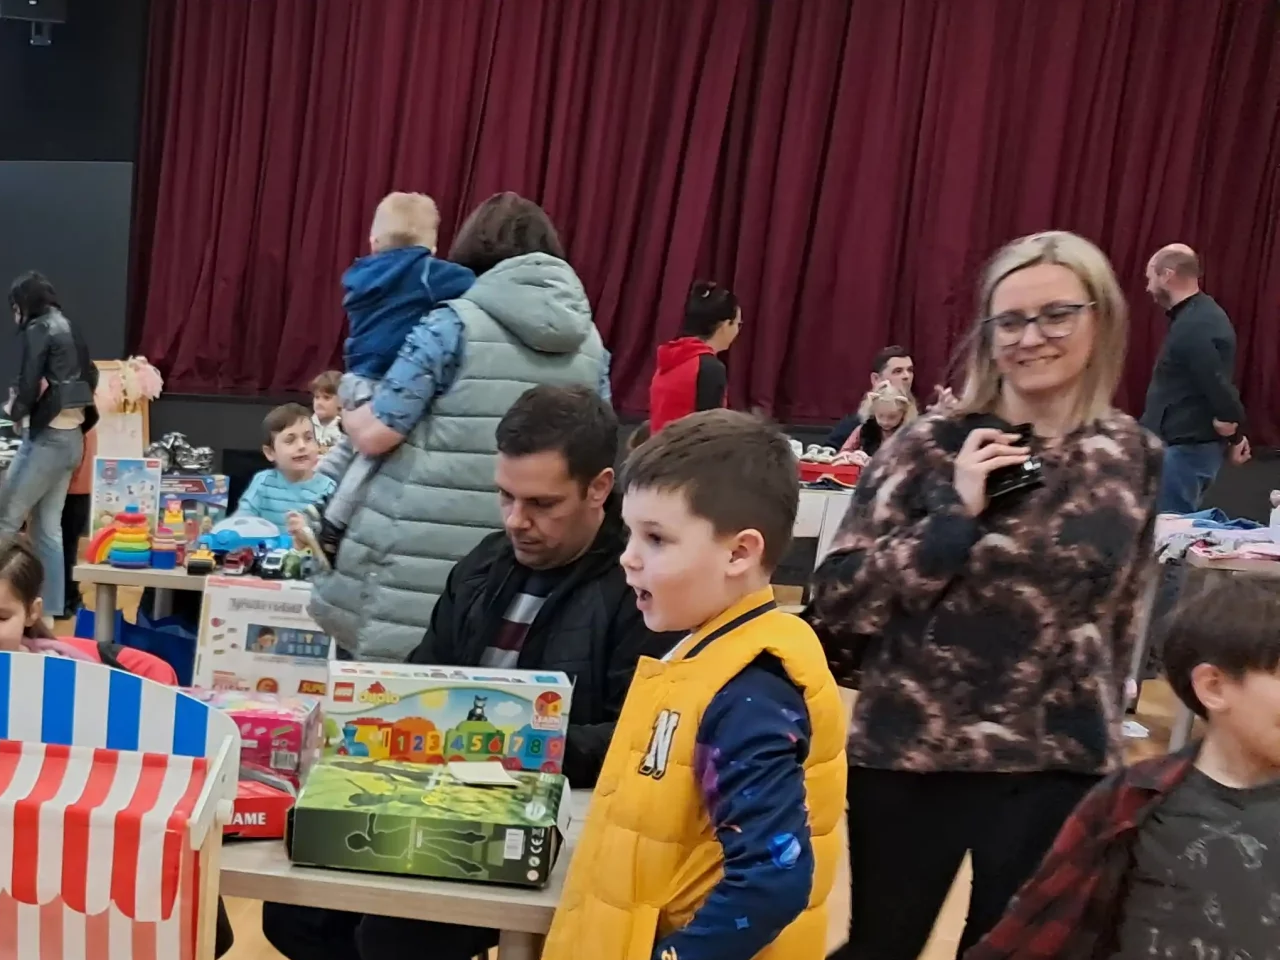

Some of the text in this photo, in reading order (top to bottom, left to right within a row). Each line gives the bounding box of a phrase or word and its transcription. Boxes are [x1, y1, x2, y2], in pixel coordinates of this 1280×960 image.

[397, 735, 405, 752] 1
[413, 735, 424, 752] 2
[428, 734, 440, 752] 3
[450, 734, 465, 751] 4
[470, 734, 483, 752] 5
[512, 736, 524, 754] 7
[530, 738, 542, 755] 8
[638, 708, 681, 780] N
[232, 812, 267, 826] AME
